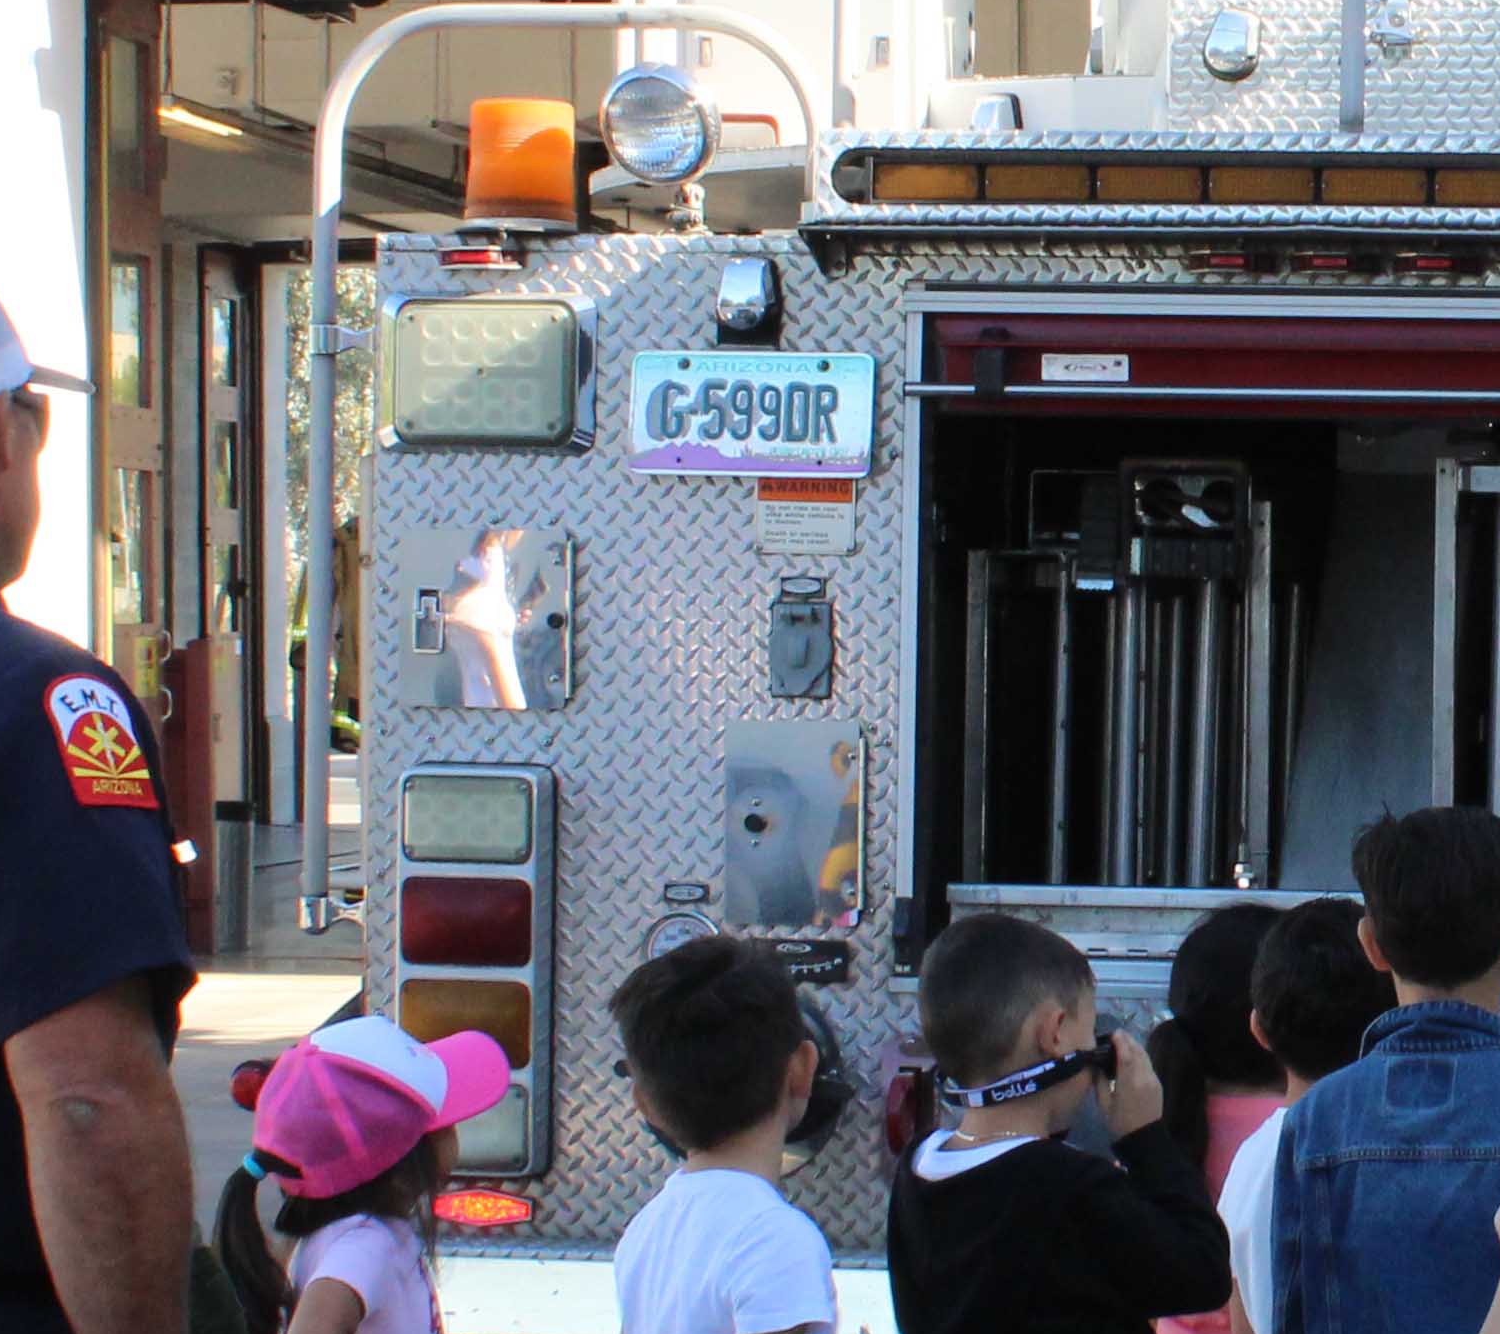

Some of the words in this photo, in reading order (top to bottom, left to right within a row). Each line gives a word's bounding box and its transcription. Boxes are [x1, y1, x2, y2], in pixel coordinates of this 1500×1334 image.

[696, 358, 811, 373] ARIZONA
[656, 377, 839, 445] G-599DR
[776, 481, 850, 494] WARNING
[92, 780, 143, 795] ARIZONA
